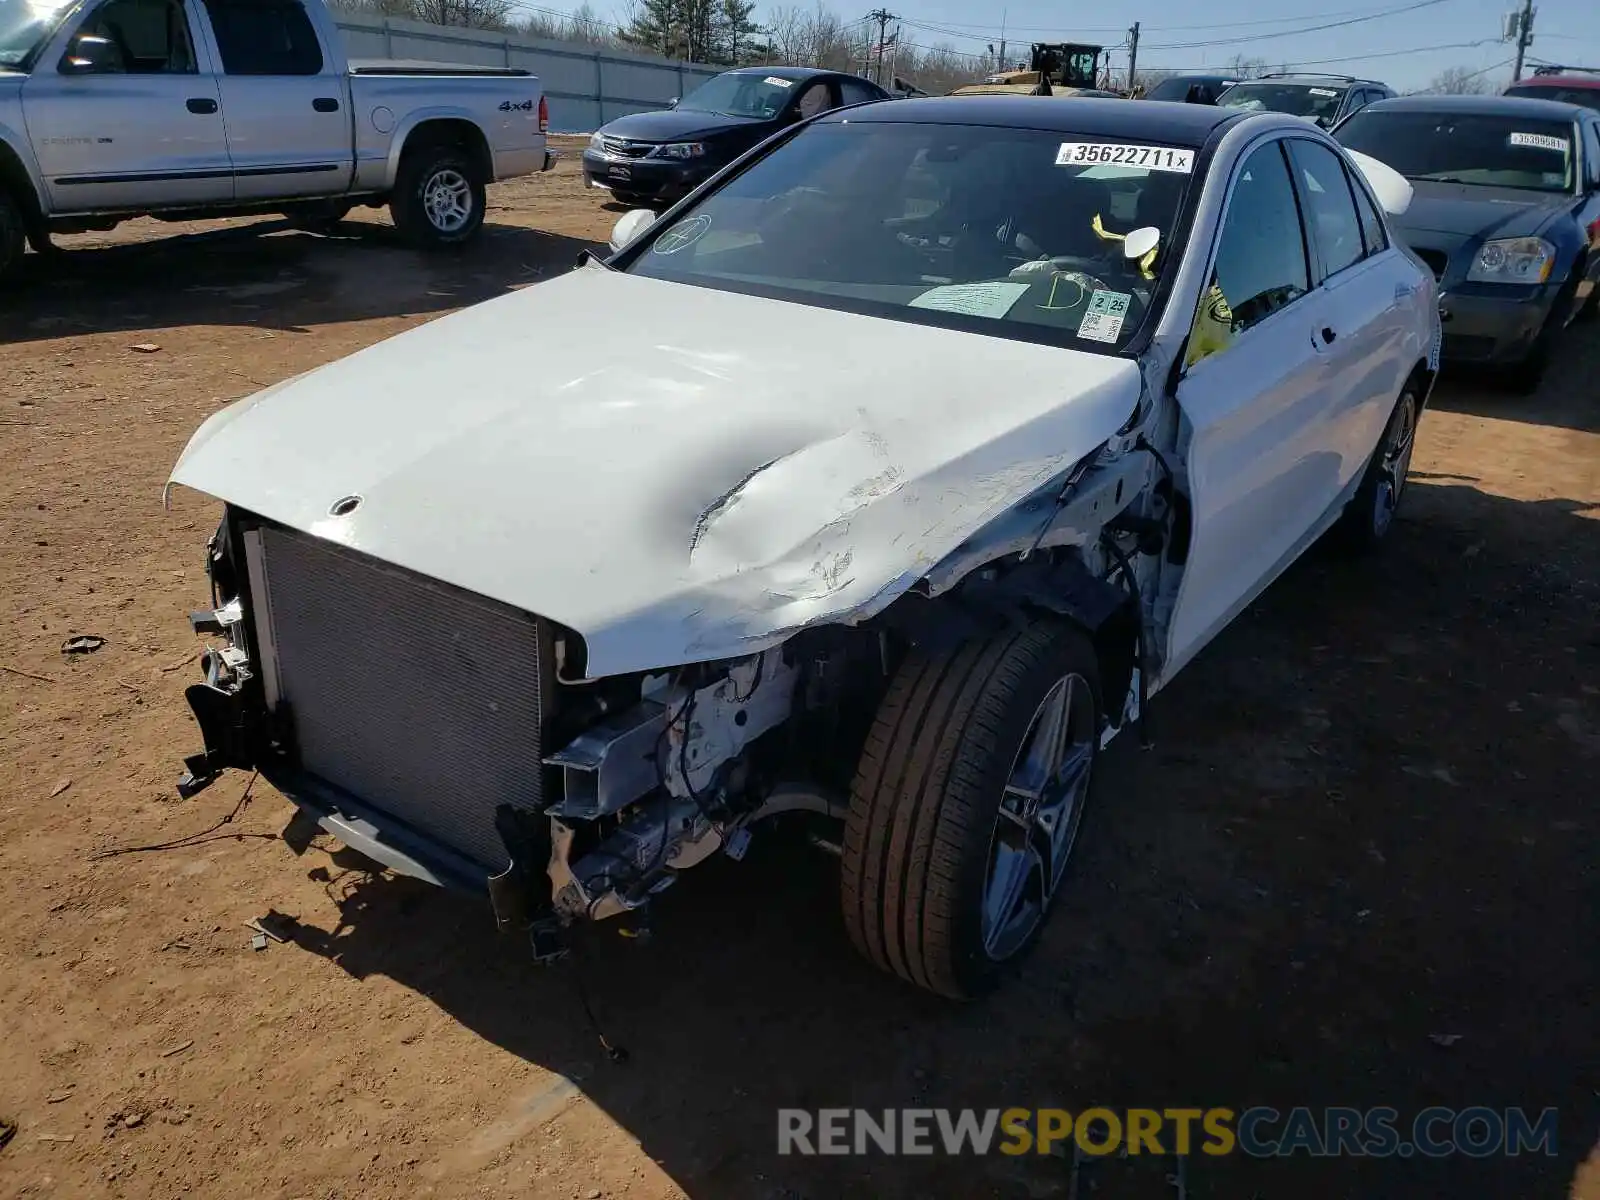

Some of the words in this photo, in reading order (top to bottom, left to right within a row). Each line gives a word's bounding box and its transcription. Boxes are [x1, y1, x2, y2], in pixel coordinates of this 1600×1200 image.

[498, 99, 533, 112] 4x4
[1074, 145, 1174, 167] 35622711
[1034, 270, 1085, 310] D
[1094, 297, 1105, 308] 2
[1109, 299, 1125, 312] 25
